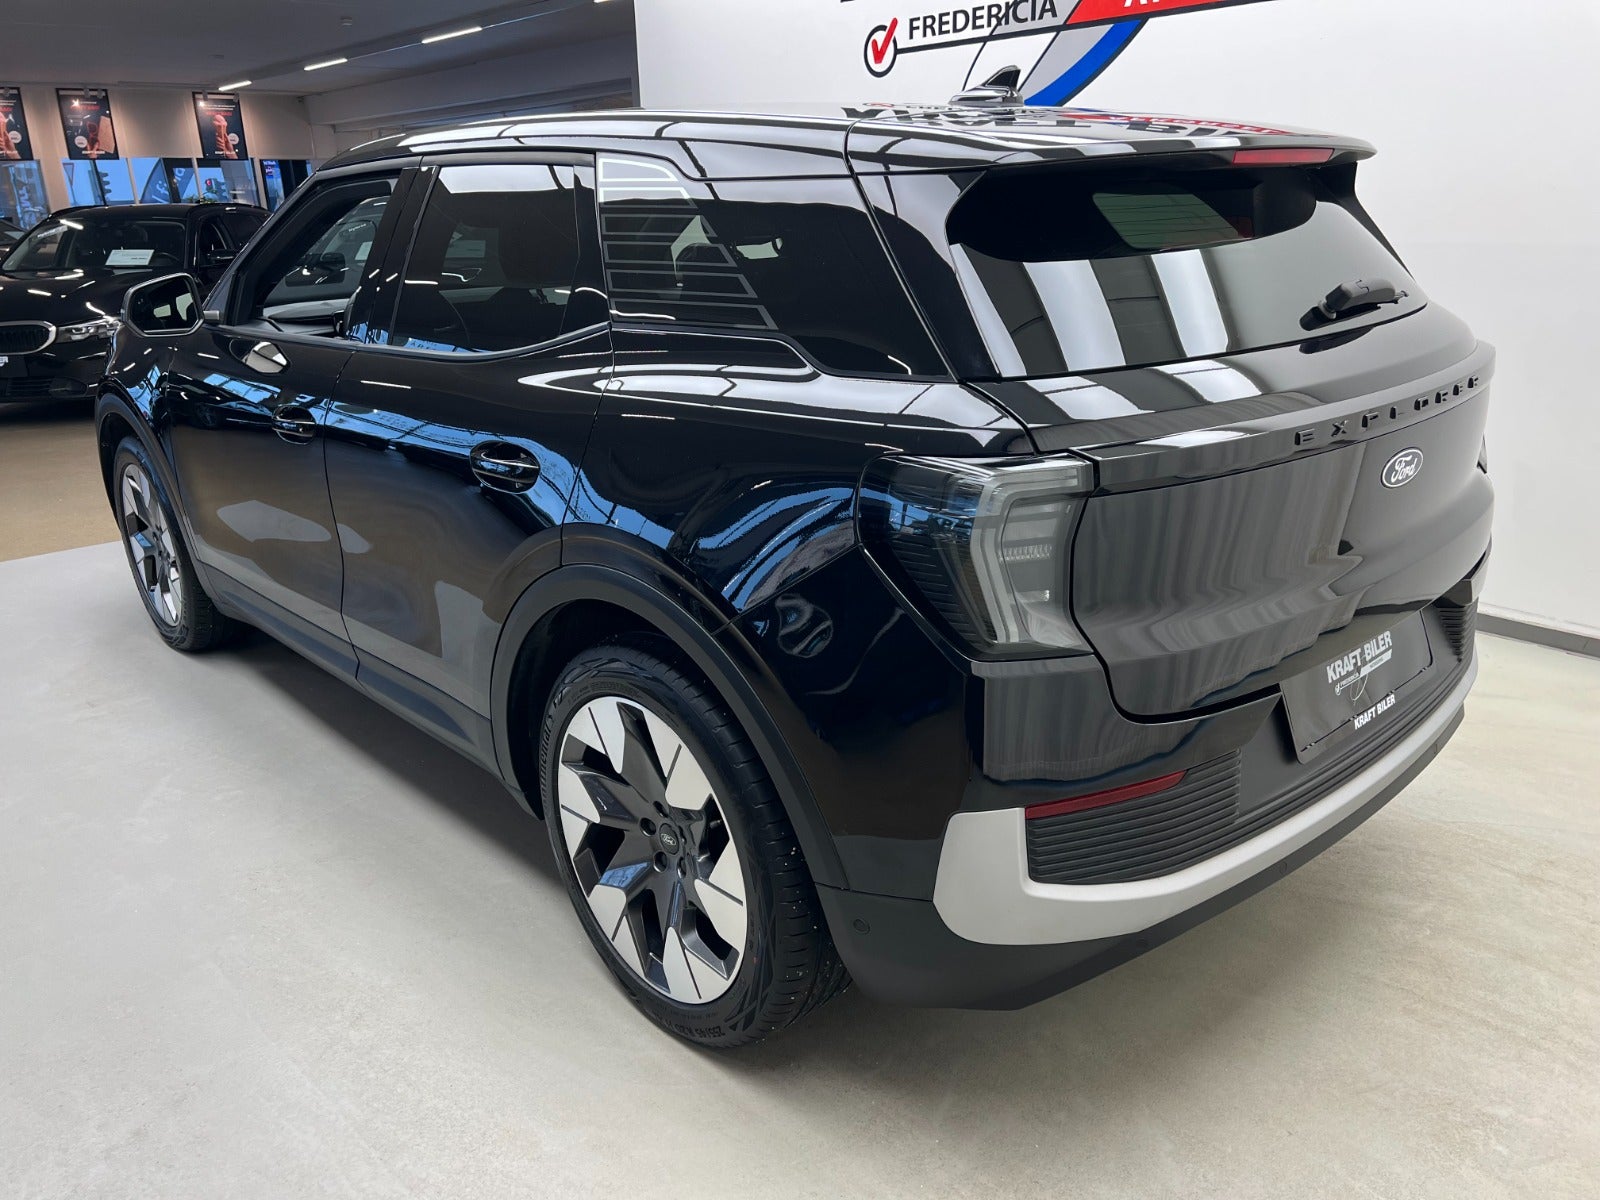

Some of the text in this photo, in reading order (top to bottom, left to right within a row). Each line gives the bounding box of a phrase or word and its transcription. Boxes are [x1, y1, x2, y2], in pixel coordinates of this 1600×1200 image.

[908, 0, 1058, 40] FREDERICIA
[1294, 376, 1479, 446] EXPLORER
[1390, 455, 1419, 483] Ford
[1326, 648, 1361, 684] KRAFT
[1363, 630, 1393, 662] BILER
[1354, 693, 1396, 730] KRAFT BILER
